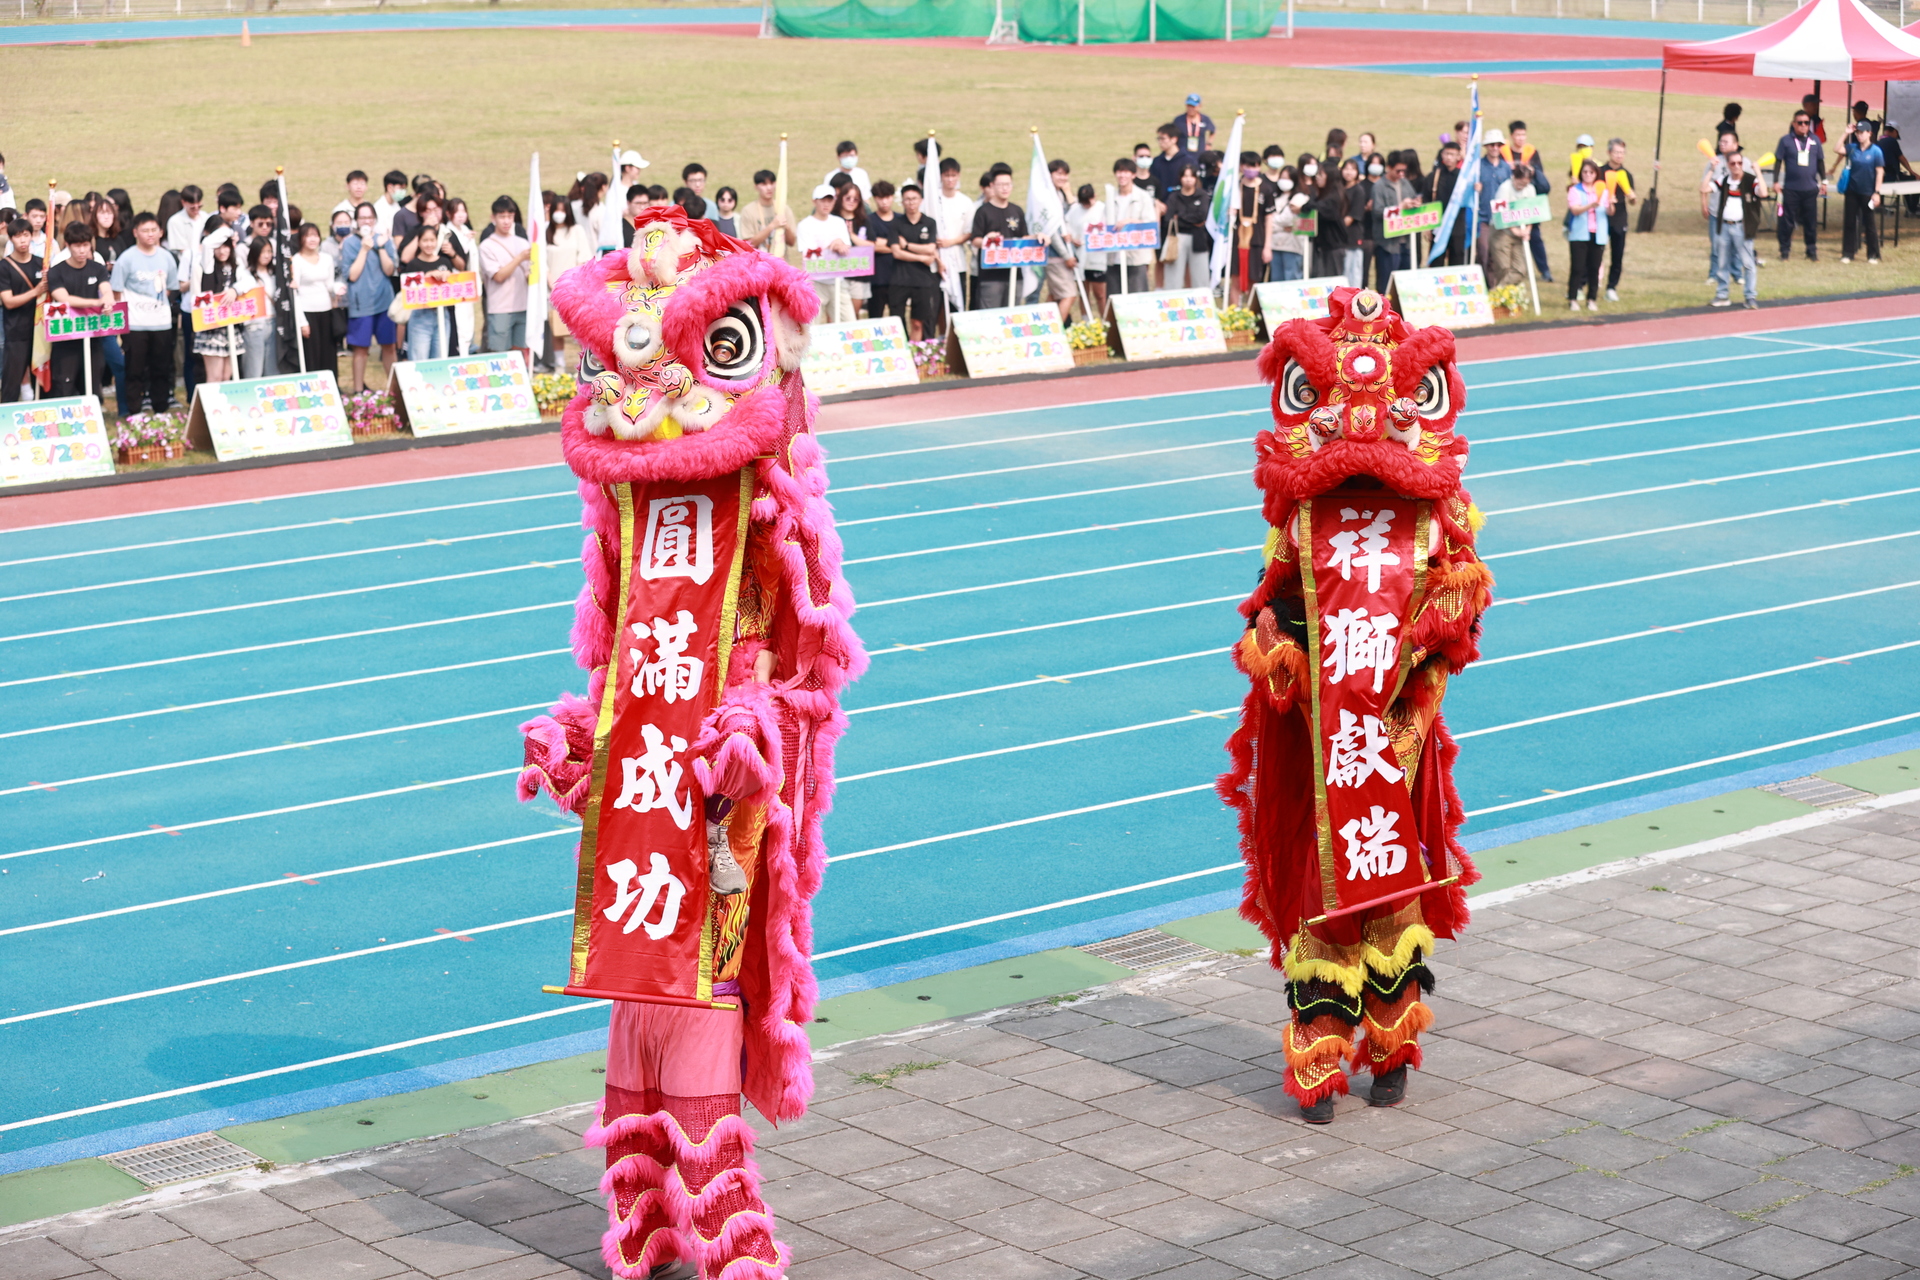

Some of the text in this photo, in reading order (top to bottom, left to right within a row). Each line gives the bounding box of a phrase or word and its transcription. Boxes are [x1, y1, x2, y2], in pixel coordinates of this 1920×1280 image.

[1502, 207, 1540, 222] EMBA
[1089, 230, 1155, 247] 生命科學系
[985, 247, 1044, 263] 應用化學系
[1460, 273, 1479, 281] NUK
[406, 282, 474, 303] 財經法律學系
[1187, 296, 1209, 305] NUK
[204, 298, 256, 323] 法律學系
[1031, 311, 1055, 321] NUK
[49, 312, 125, 335] 運動競技學系
[873, 325, 899, 337] NUK
[490, 360, 518, 372] NUK
[299, 380, 329, 393] NUK
[61, 405, 94, 419] NUK
[1323, 507, 1408, 881] 祥獅獻瑞
[603, 494, 713, 940] 圓滿成功
